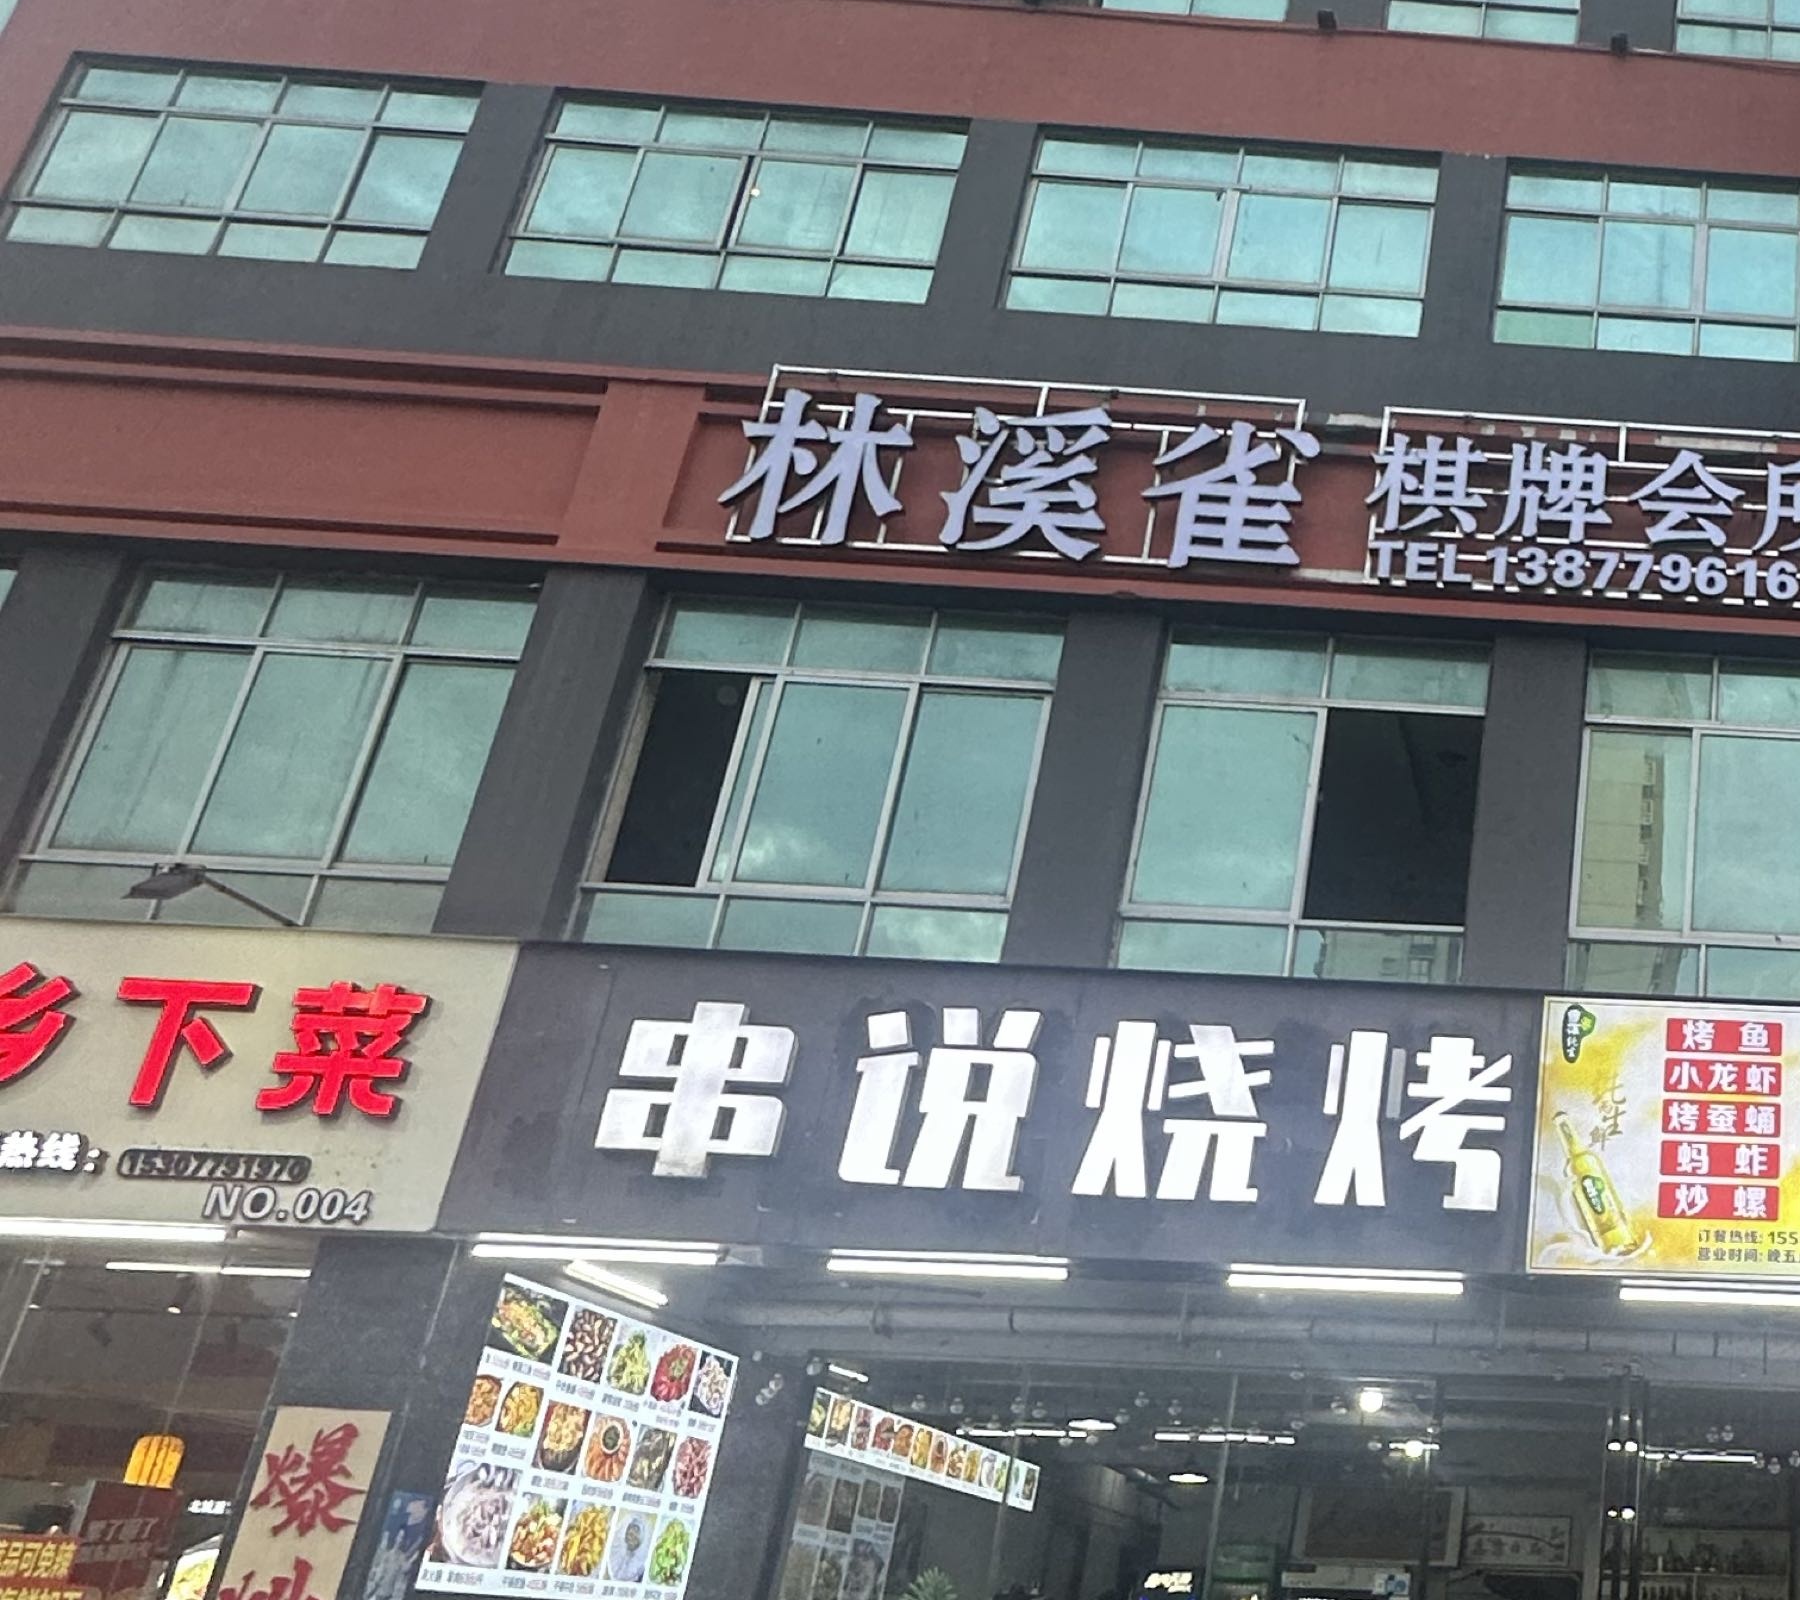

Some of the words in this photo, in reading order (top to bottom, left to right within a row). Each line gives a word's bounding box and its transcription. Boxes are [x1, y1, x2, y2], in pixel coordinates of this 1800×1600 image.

[1681, 1020, 1771, 1053] 烤鱼
[1668, 1061, 1777, 1094] 小龙虾
[595, 1001, 1513, 1213] 串说烧烤
[1667, 1101, 1776, 1135] 烤蚕蛹
[1675, 1142, 1769, 1177] 蚂蚱
[203, 1184, 374, 1224] NO.004
[1674, 1183, 1768, 1218] 炒螺
